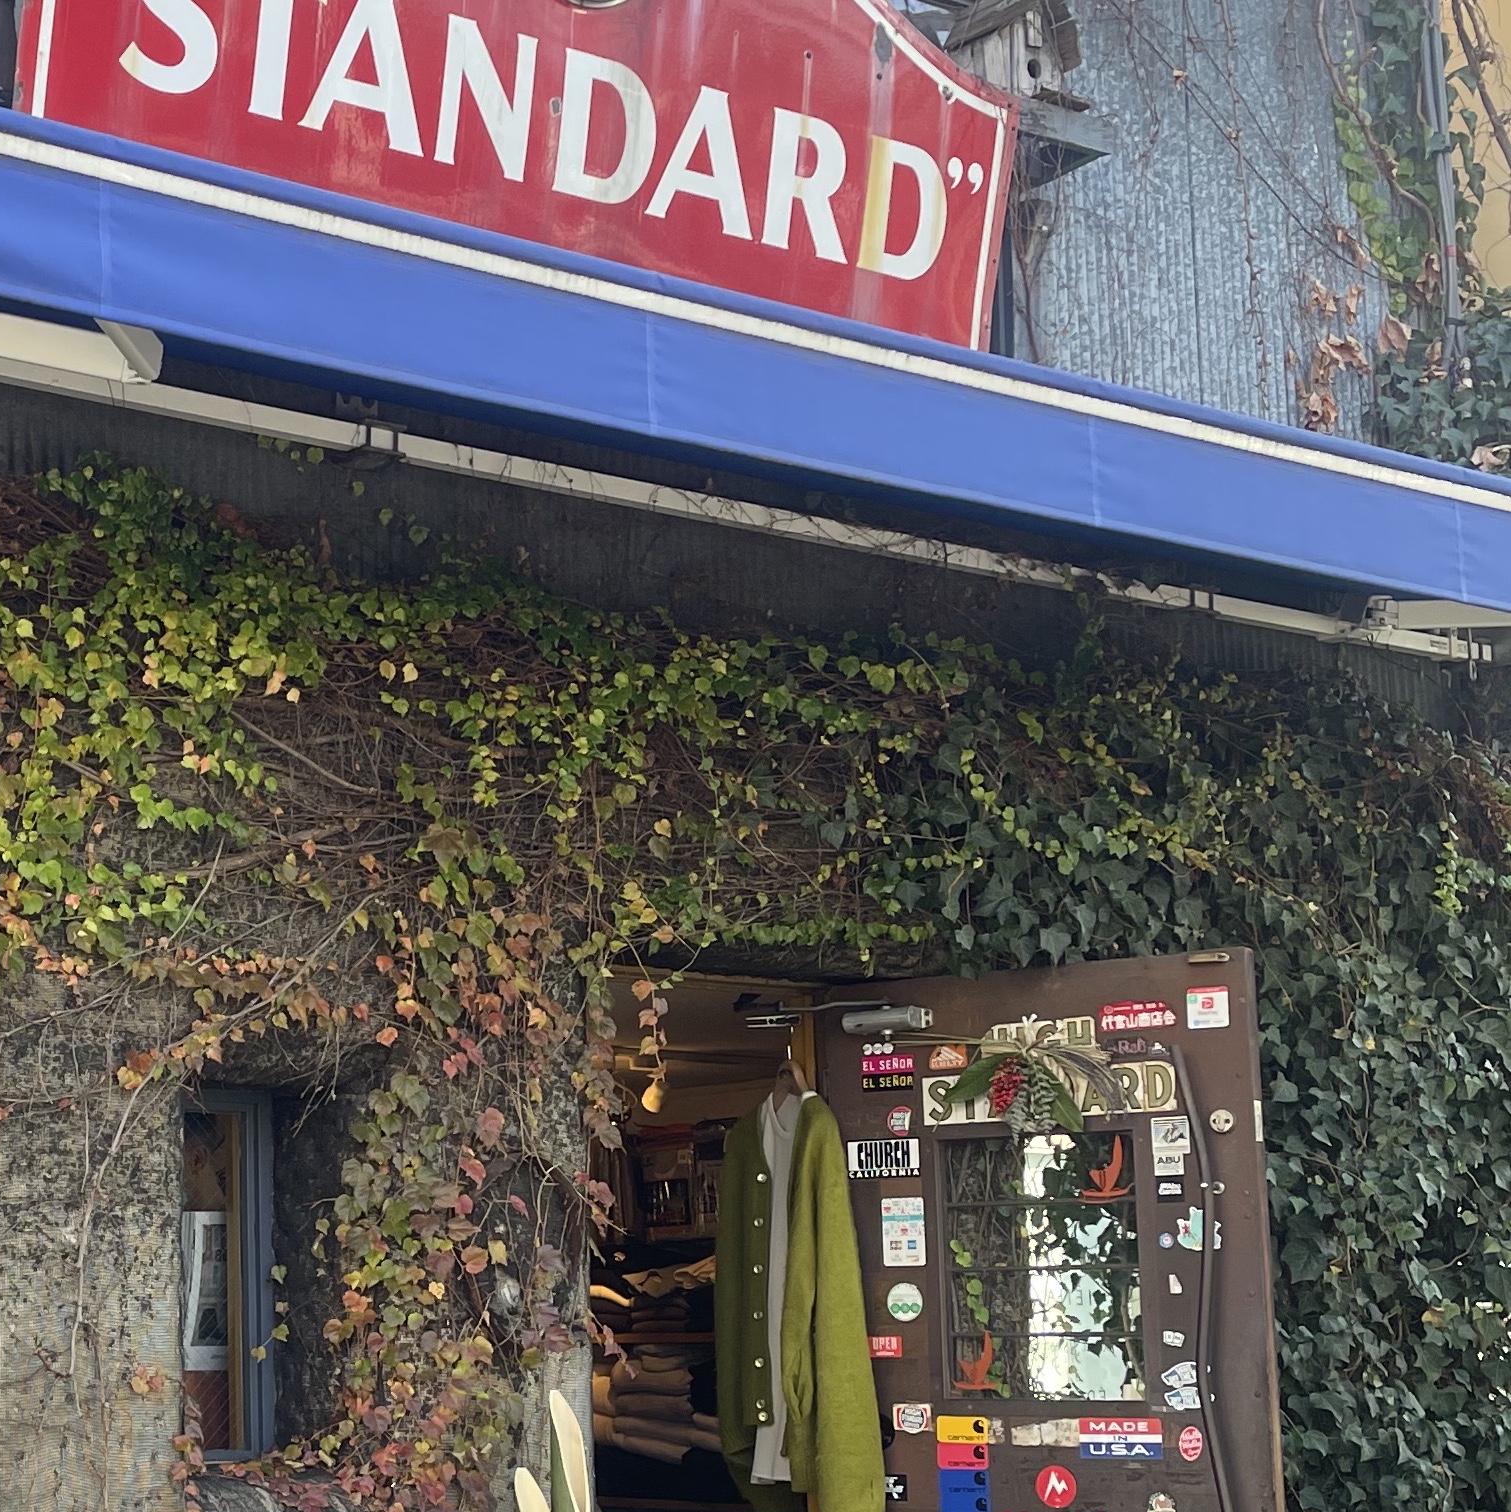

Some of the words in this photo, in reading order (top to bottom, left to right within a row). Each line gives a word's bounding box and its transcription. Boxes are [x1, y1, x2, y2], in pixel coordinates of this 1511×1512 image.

[862, 1061, 876, 1072] EL
[879, 1057, 914, 1071] SEÑOR
[862, 1078, 876, 1089] EL
[879, 1075, 914, 1088] SEÑOR
[857, 1140, 911, 1170] CHURCH
[848, 1168, 920, 1179] CALIFORNIA
[872, 1336, 898, 1350] OPEN
[1089, 1421, 1149, 1432] MADE
[1089, 1443, 1155, 1456] U.S.A.
